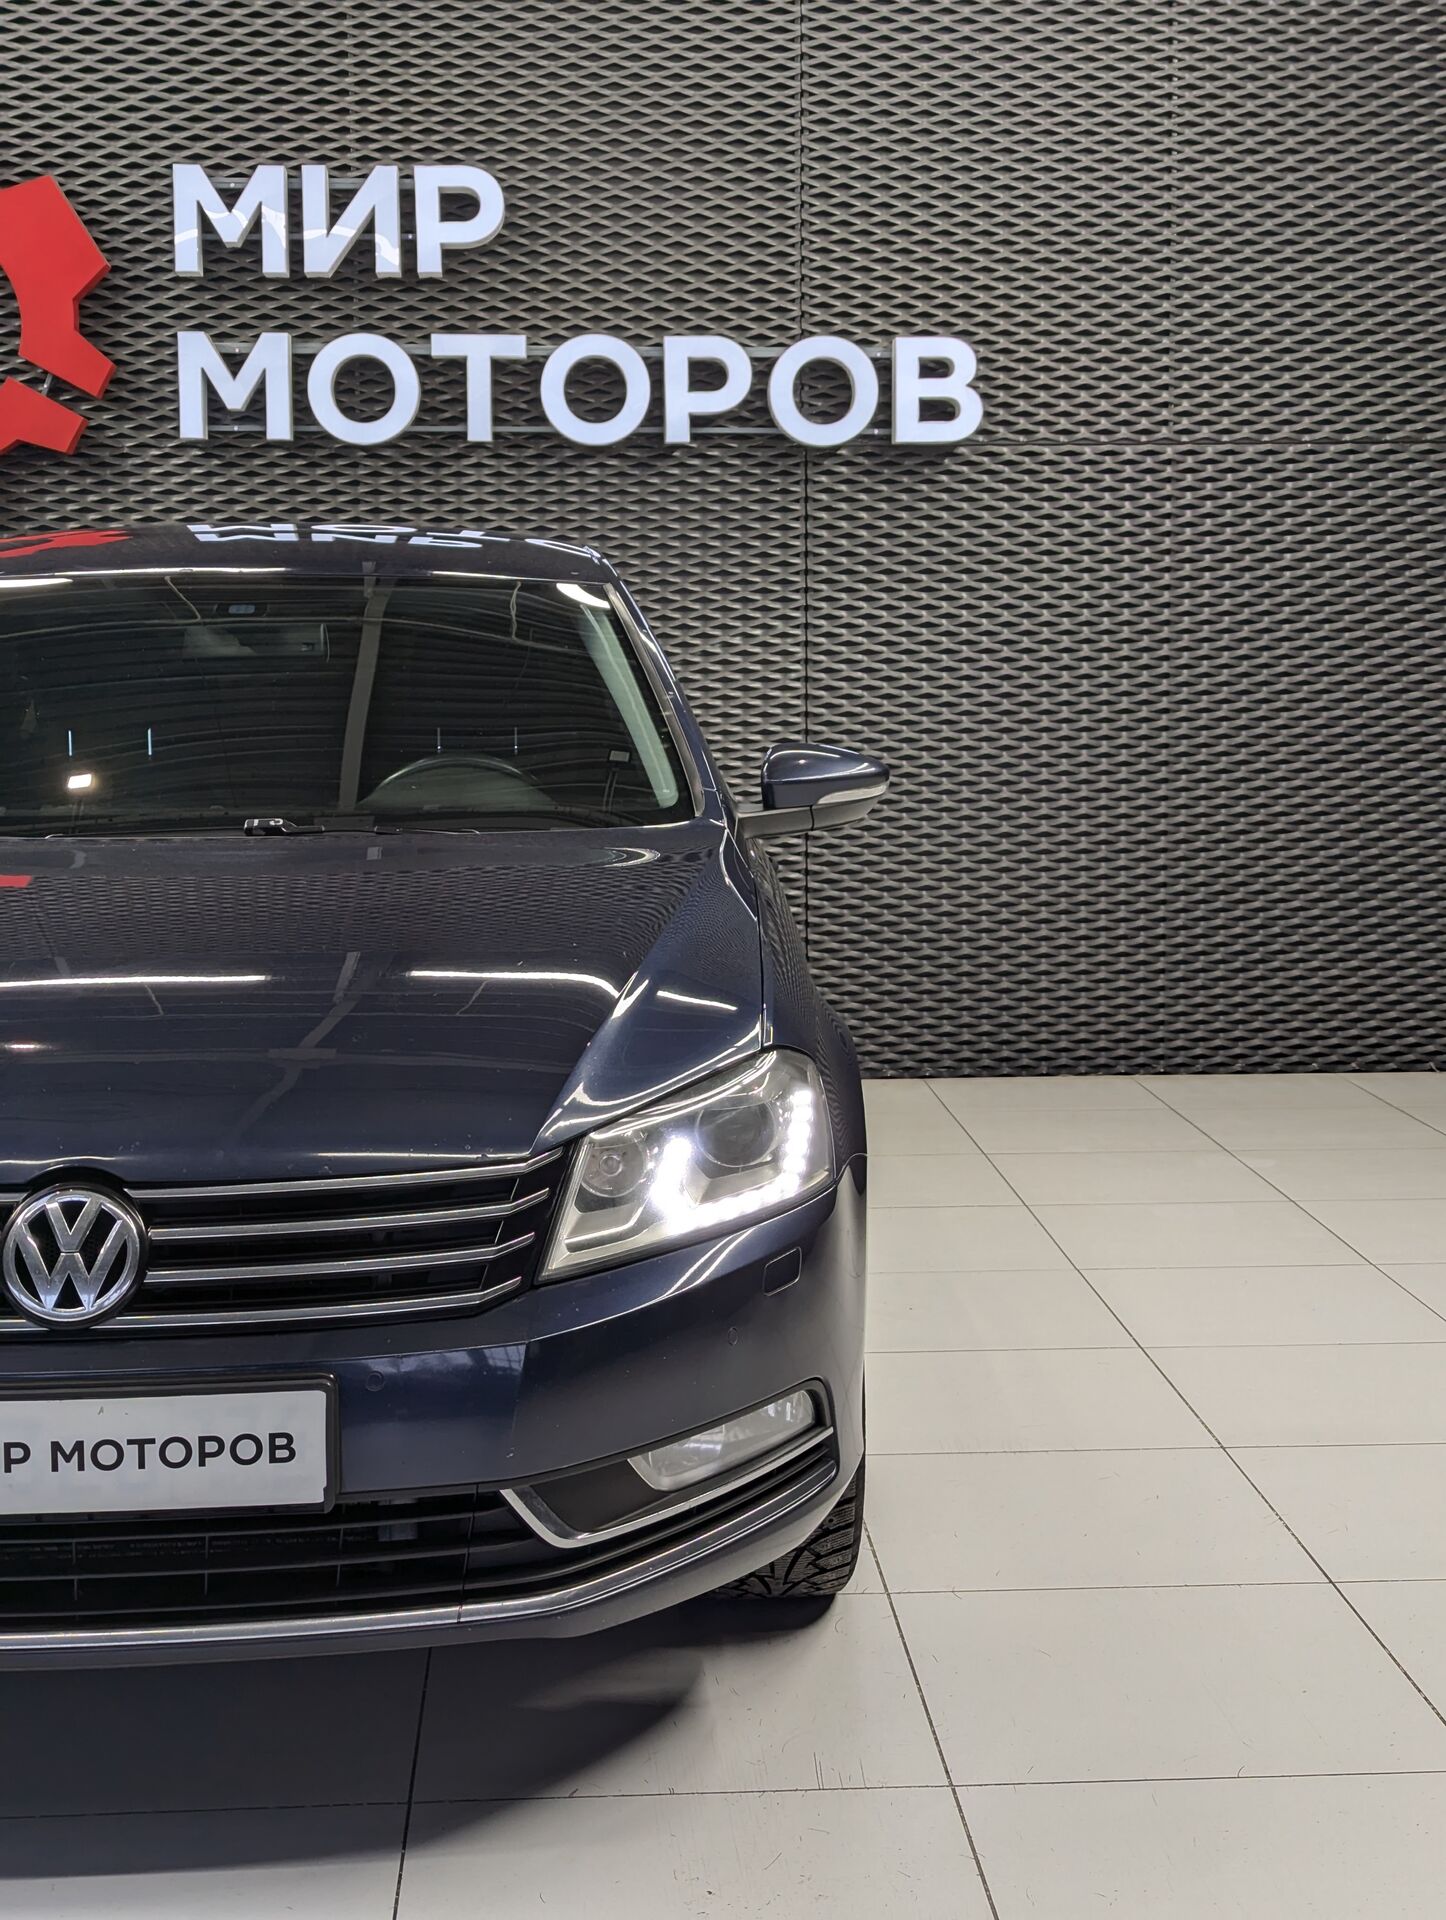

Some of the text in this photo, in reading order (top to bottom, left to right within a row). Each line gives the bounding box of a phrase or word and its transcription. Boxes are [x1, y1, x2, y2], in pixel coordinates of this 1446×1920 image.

[173, 164, 505, 278] МИР
[177, 331, 984, 445] МОТОРОВ
[50, 1431, 297, 1473] МОТОРОВ
